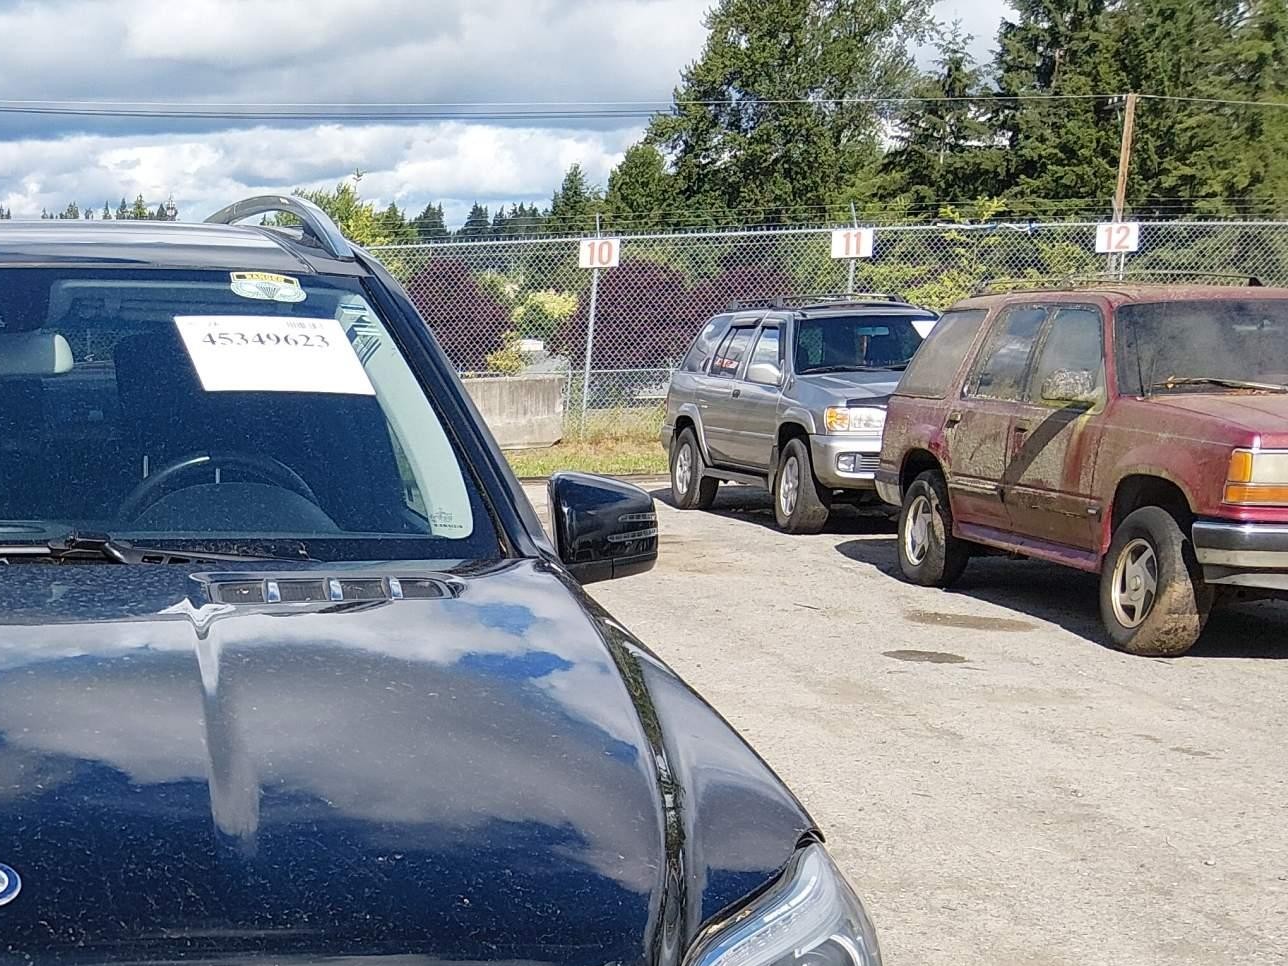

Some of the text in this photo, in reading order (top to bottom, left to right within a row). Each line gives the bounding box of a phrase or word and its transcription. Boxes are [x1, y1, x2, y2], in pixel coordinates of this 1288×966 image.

[843, 231, 861, 256] 11
[1104, 225, 1130, 250] 12
[588, 241, 613, 266] 10
[201, 331, 331, 349] 45349623
